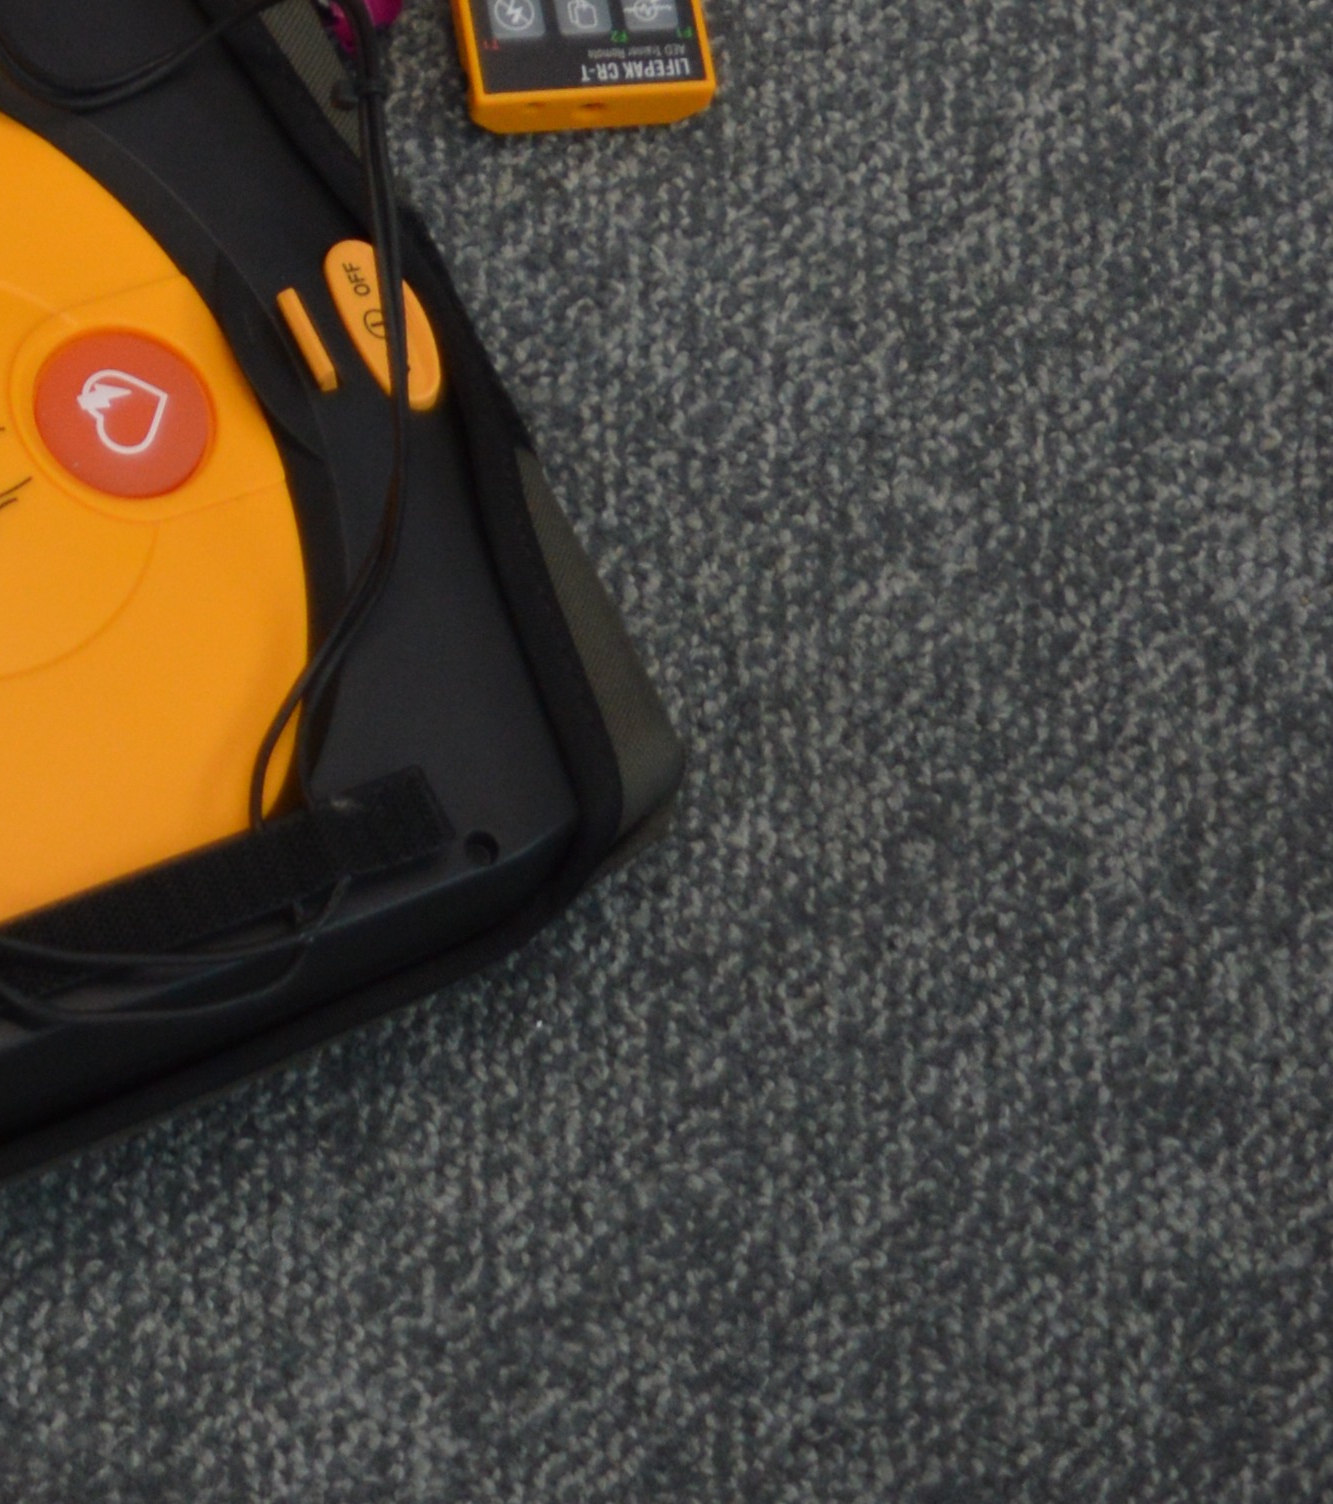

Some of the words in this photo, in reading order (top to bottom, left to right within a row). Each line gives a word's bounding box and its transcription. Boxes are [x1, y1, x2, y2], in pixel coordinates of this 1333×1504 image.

[588, 48, 626, 59] Remote
[629, 45, 662, 58] Trainer
[664, 44, 685, 56] AED
[581, 61, 620, 82] CR-T
[625, 58, 690, 79] LIFEPAK
[342, 263, 371, 296] OFF
